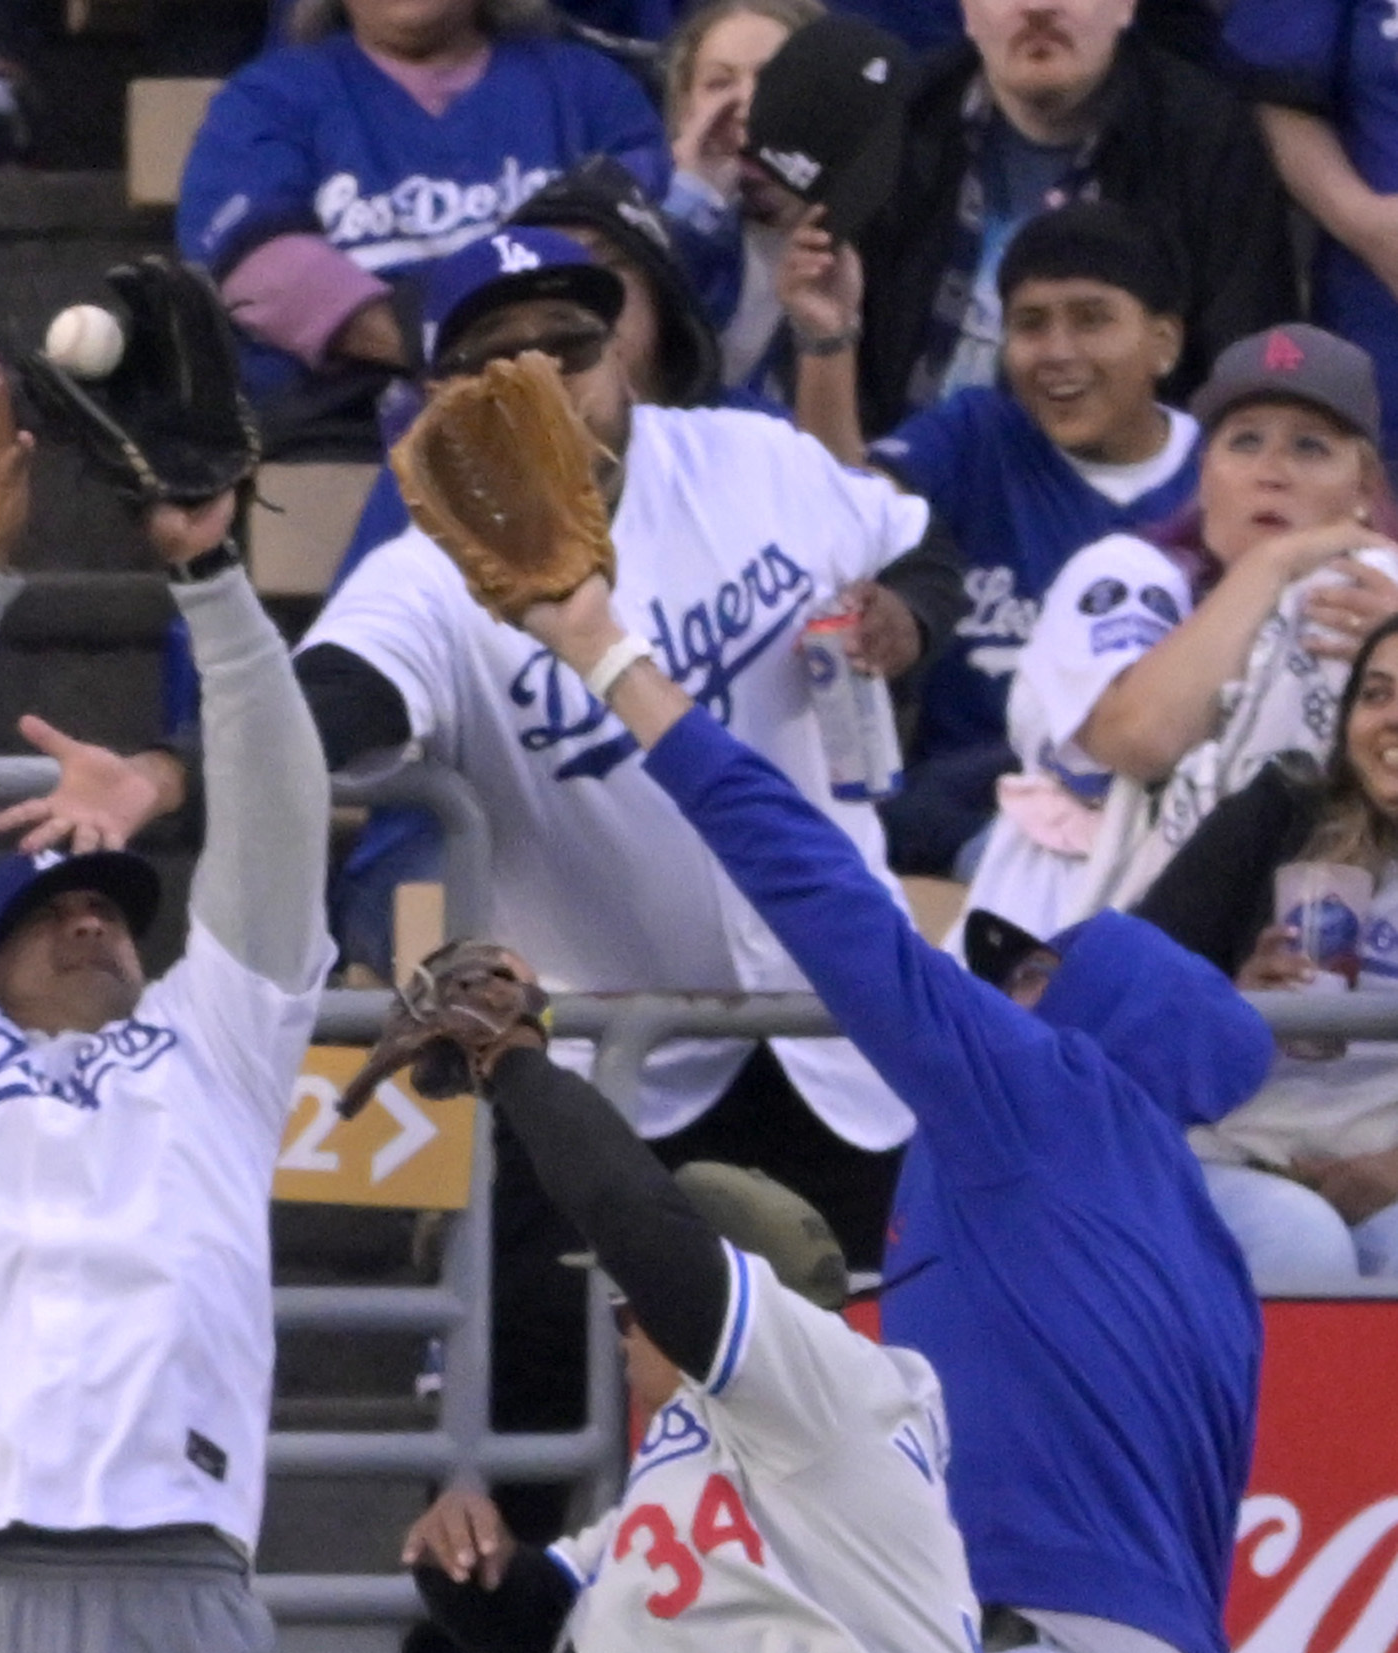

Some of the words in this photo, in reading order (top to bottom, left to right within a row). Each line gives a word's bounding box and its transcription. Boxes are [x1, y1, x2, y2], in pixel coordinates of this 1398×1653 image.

[491, 234, 542, 274] LA
[509, 543, 814, 750] Ddgers
[613, 1473, 765, 1620] 34
